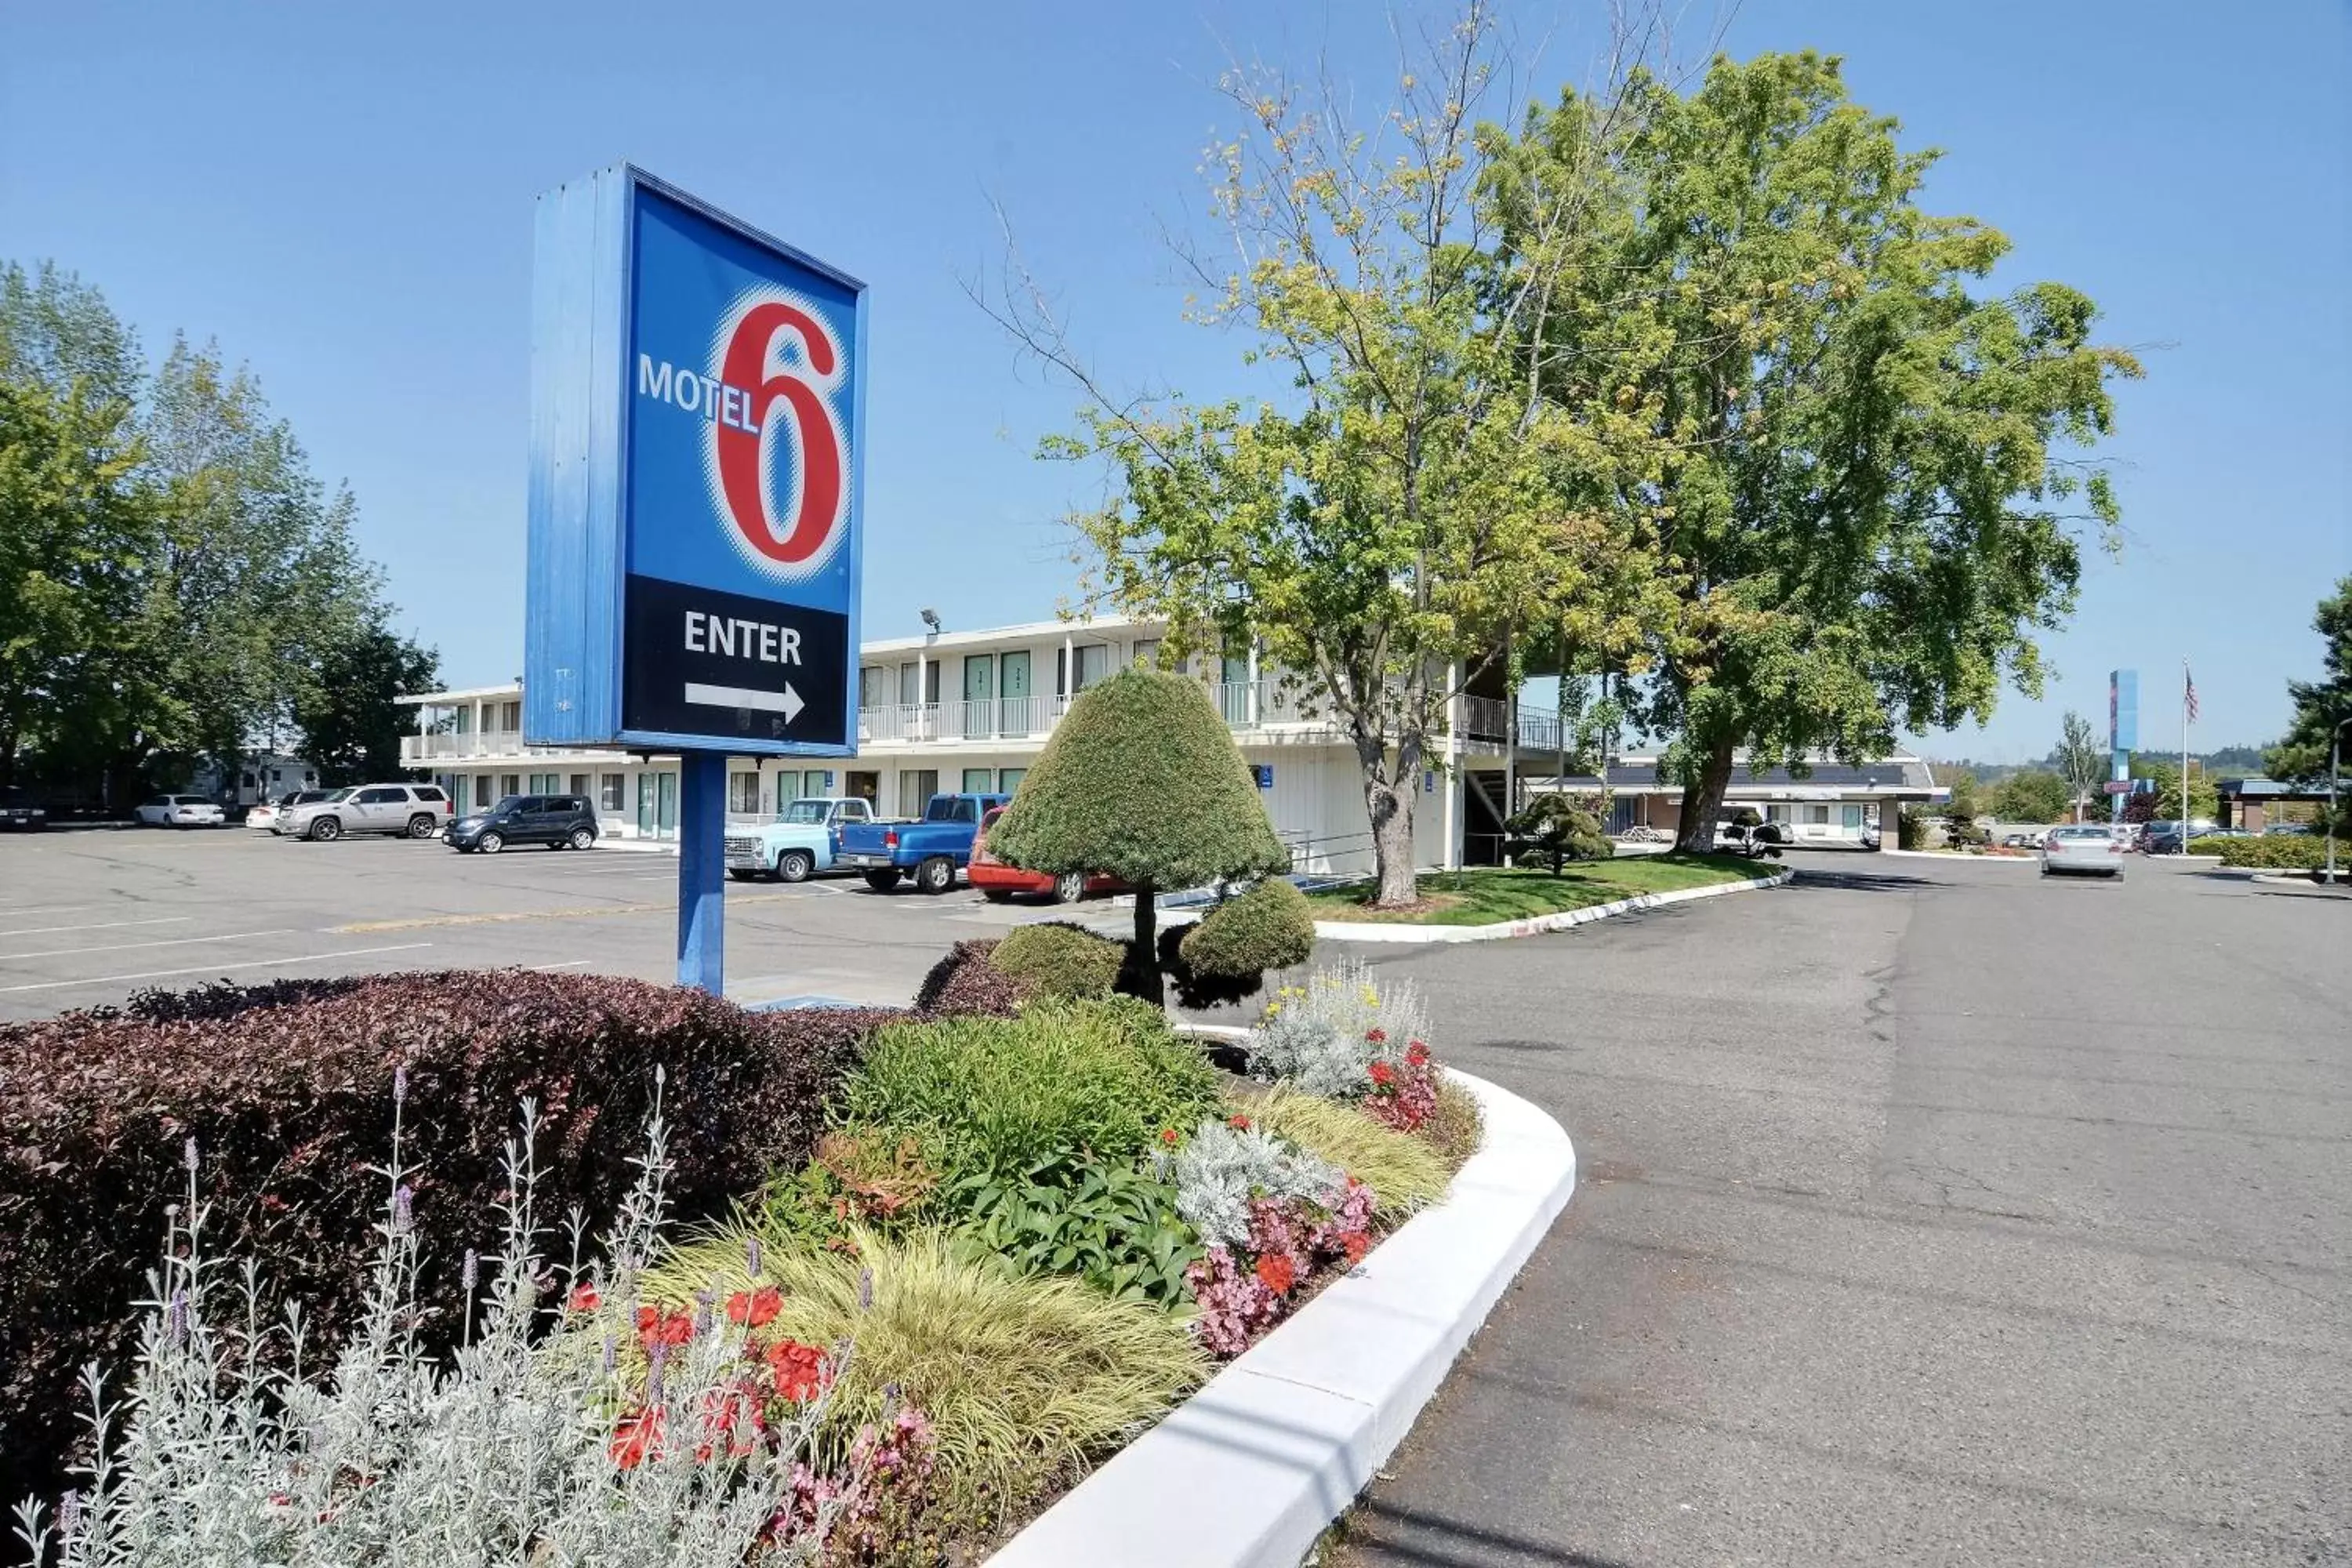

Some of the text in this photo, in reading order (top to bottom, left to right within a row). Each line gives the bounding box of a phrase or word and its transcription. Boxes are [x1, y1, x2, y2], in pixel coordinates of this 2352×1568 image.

[639, 302, 840, 563] MOTEL 6
[685, 611, 802, 666] ENTER
